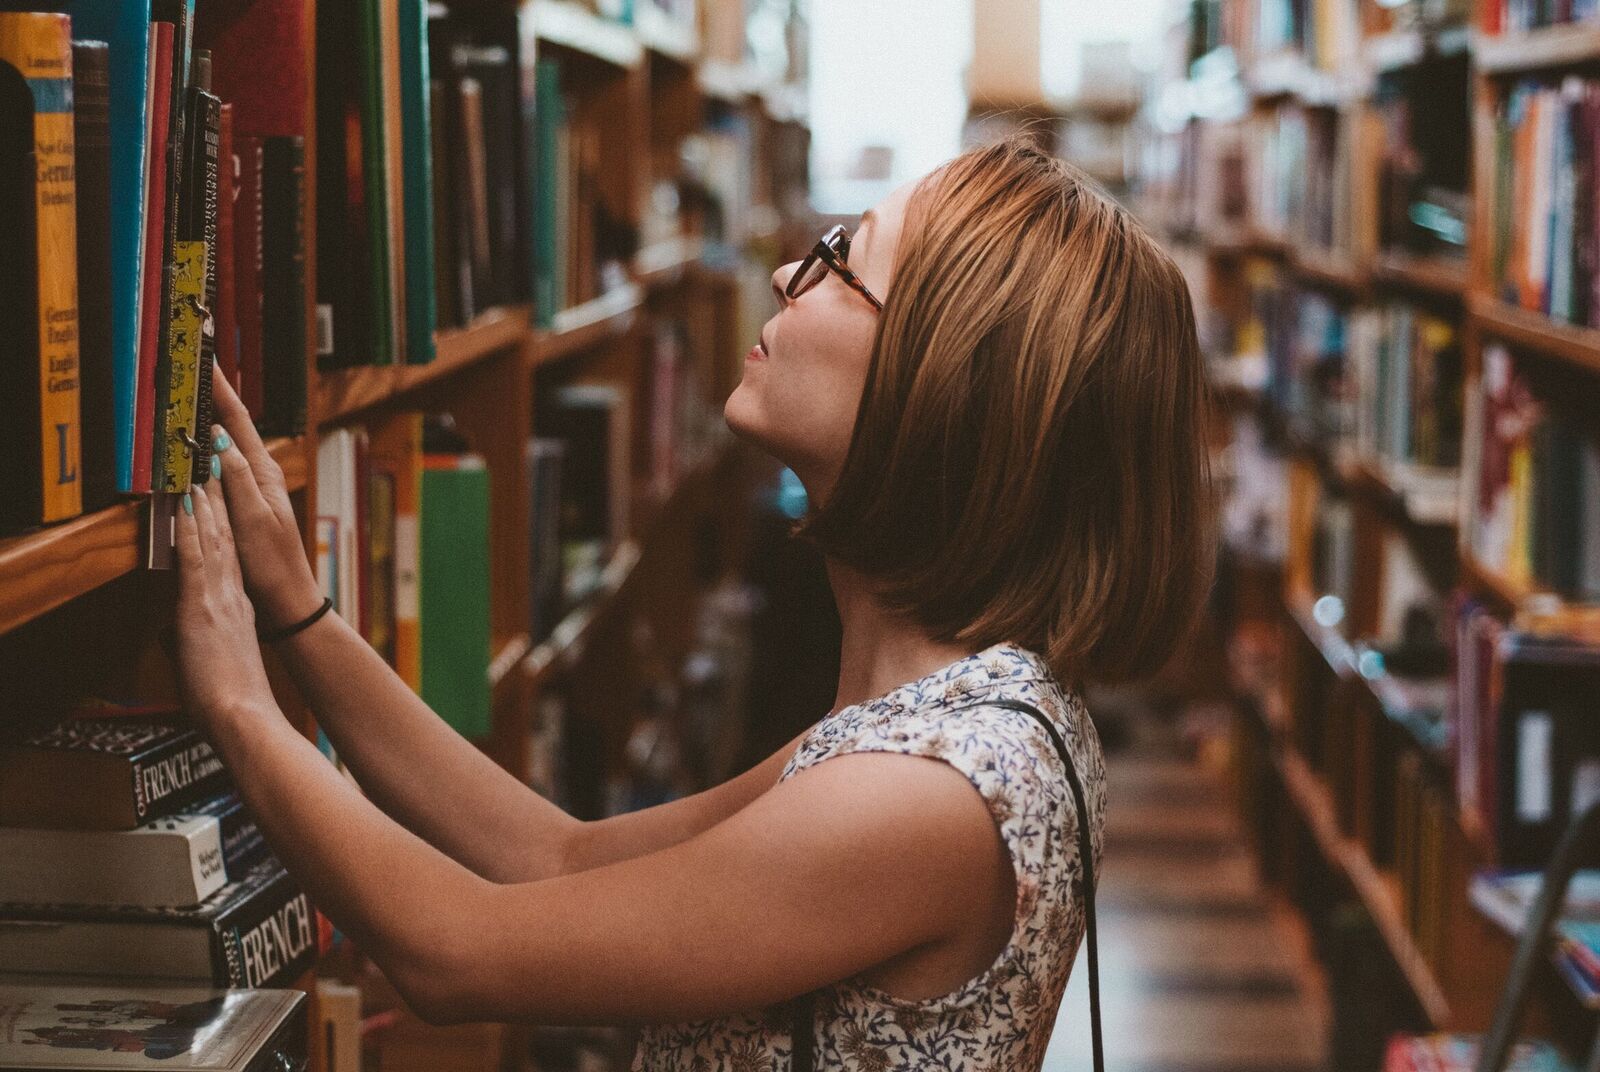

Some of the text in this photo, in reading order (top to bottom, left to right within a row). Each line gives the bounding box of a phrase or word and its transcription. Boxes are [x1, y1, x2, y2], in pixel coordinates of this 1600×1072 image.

[207, 163, 217, 281] GERMAN-ENGLISH
[56, 424, 76, 485] L
[143, 750, 192, 804] FRENCH
[241, 893, 312, 990] FRENCH
